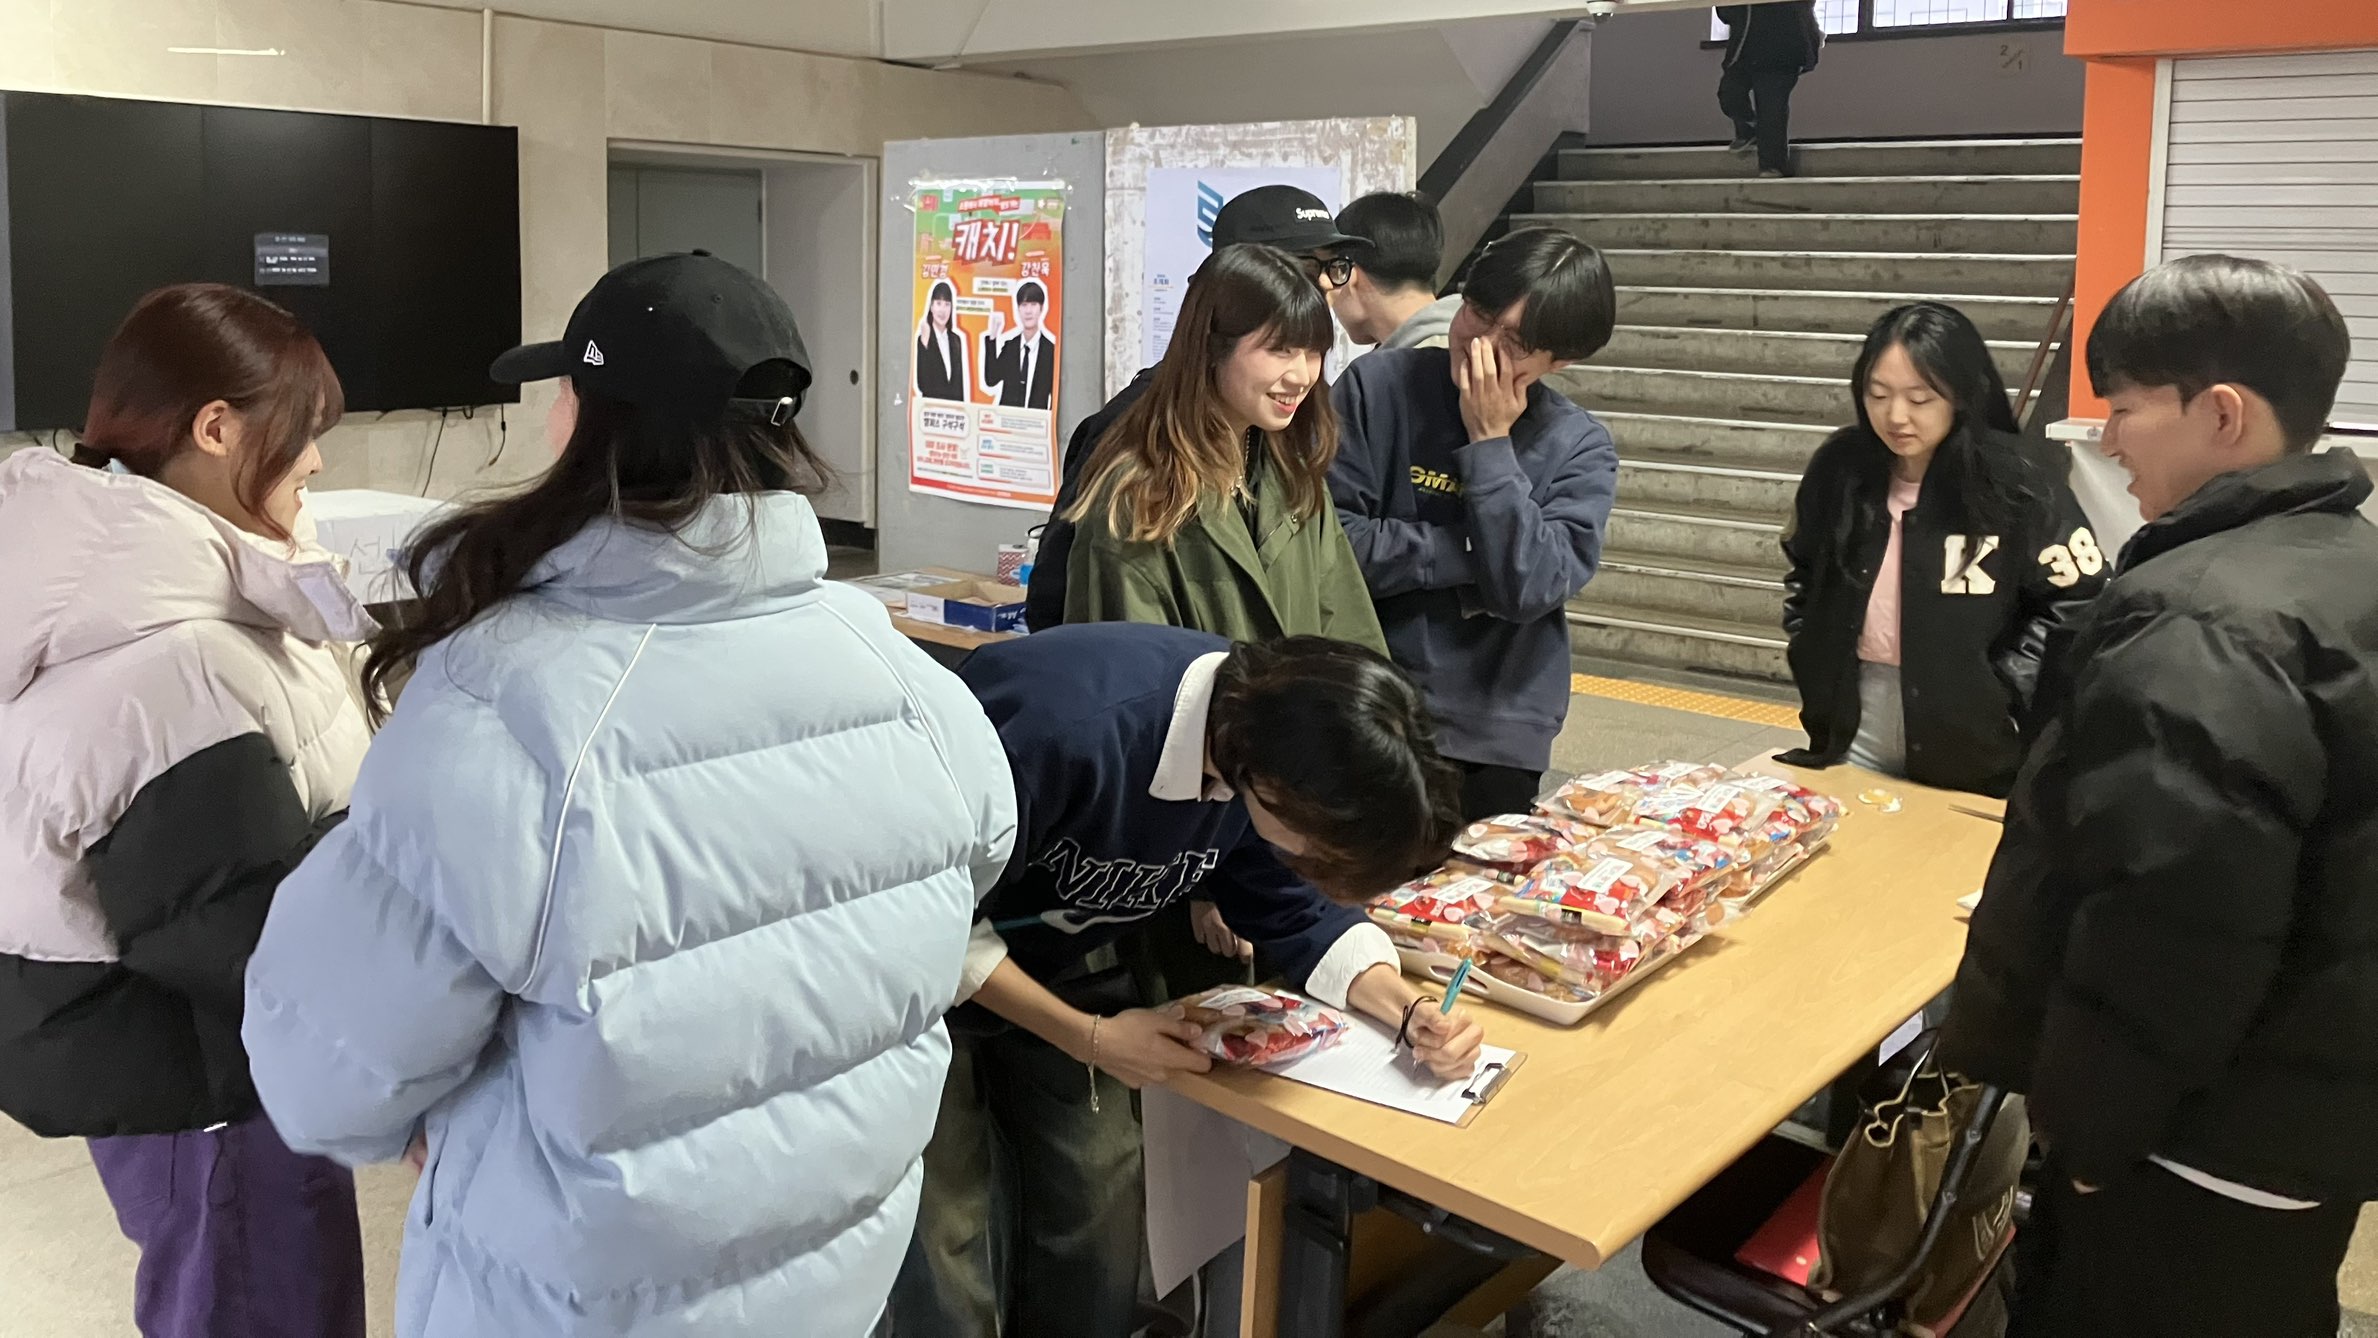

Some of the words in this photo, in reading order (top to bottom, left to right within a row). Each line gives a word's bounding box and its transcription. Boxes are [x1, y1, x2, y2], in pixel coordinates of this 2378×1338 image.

[955, 221, 1019, 262] 캐치!
[1941, 534, 2000, 595] K
[2038, 526, 2103, 588] 38
